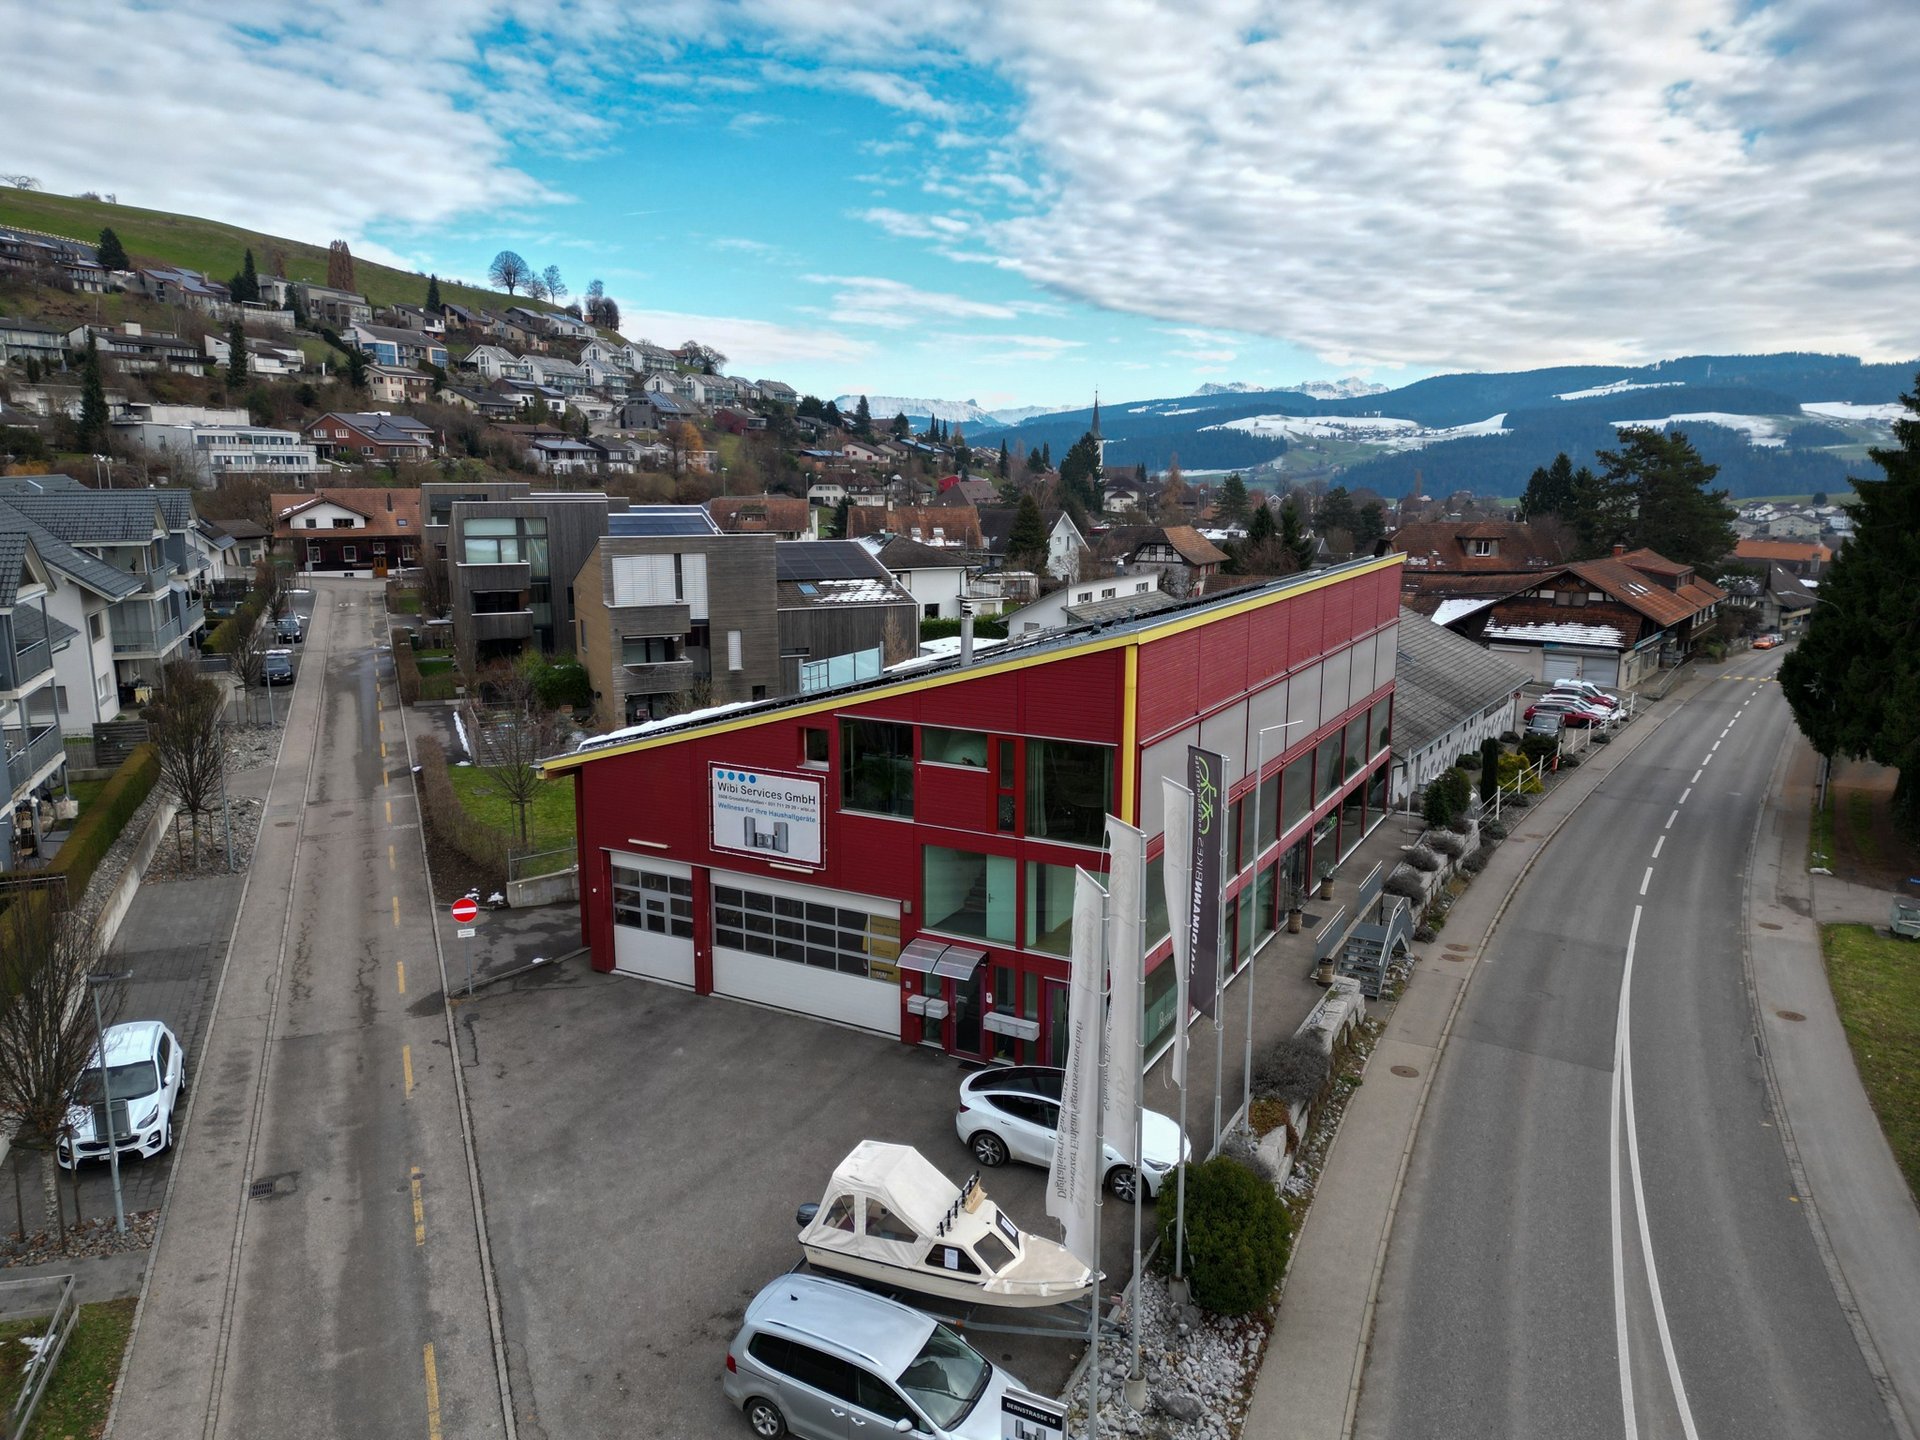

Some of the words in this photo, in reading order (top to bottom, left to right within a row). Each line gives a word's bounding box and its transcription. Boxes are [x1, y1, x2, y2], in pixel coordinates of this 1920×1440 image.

[717, 781, 738, 794] Wibi
[740, 785, 782, 800] Services
[784, 791, 816, 805] GmbH
[717, 802, 744, 811] Wellness
[754, 807, 768, 815] Ihre
[1006, 1402, 1048, 1421] BERNSTRASSE
